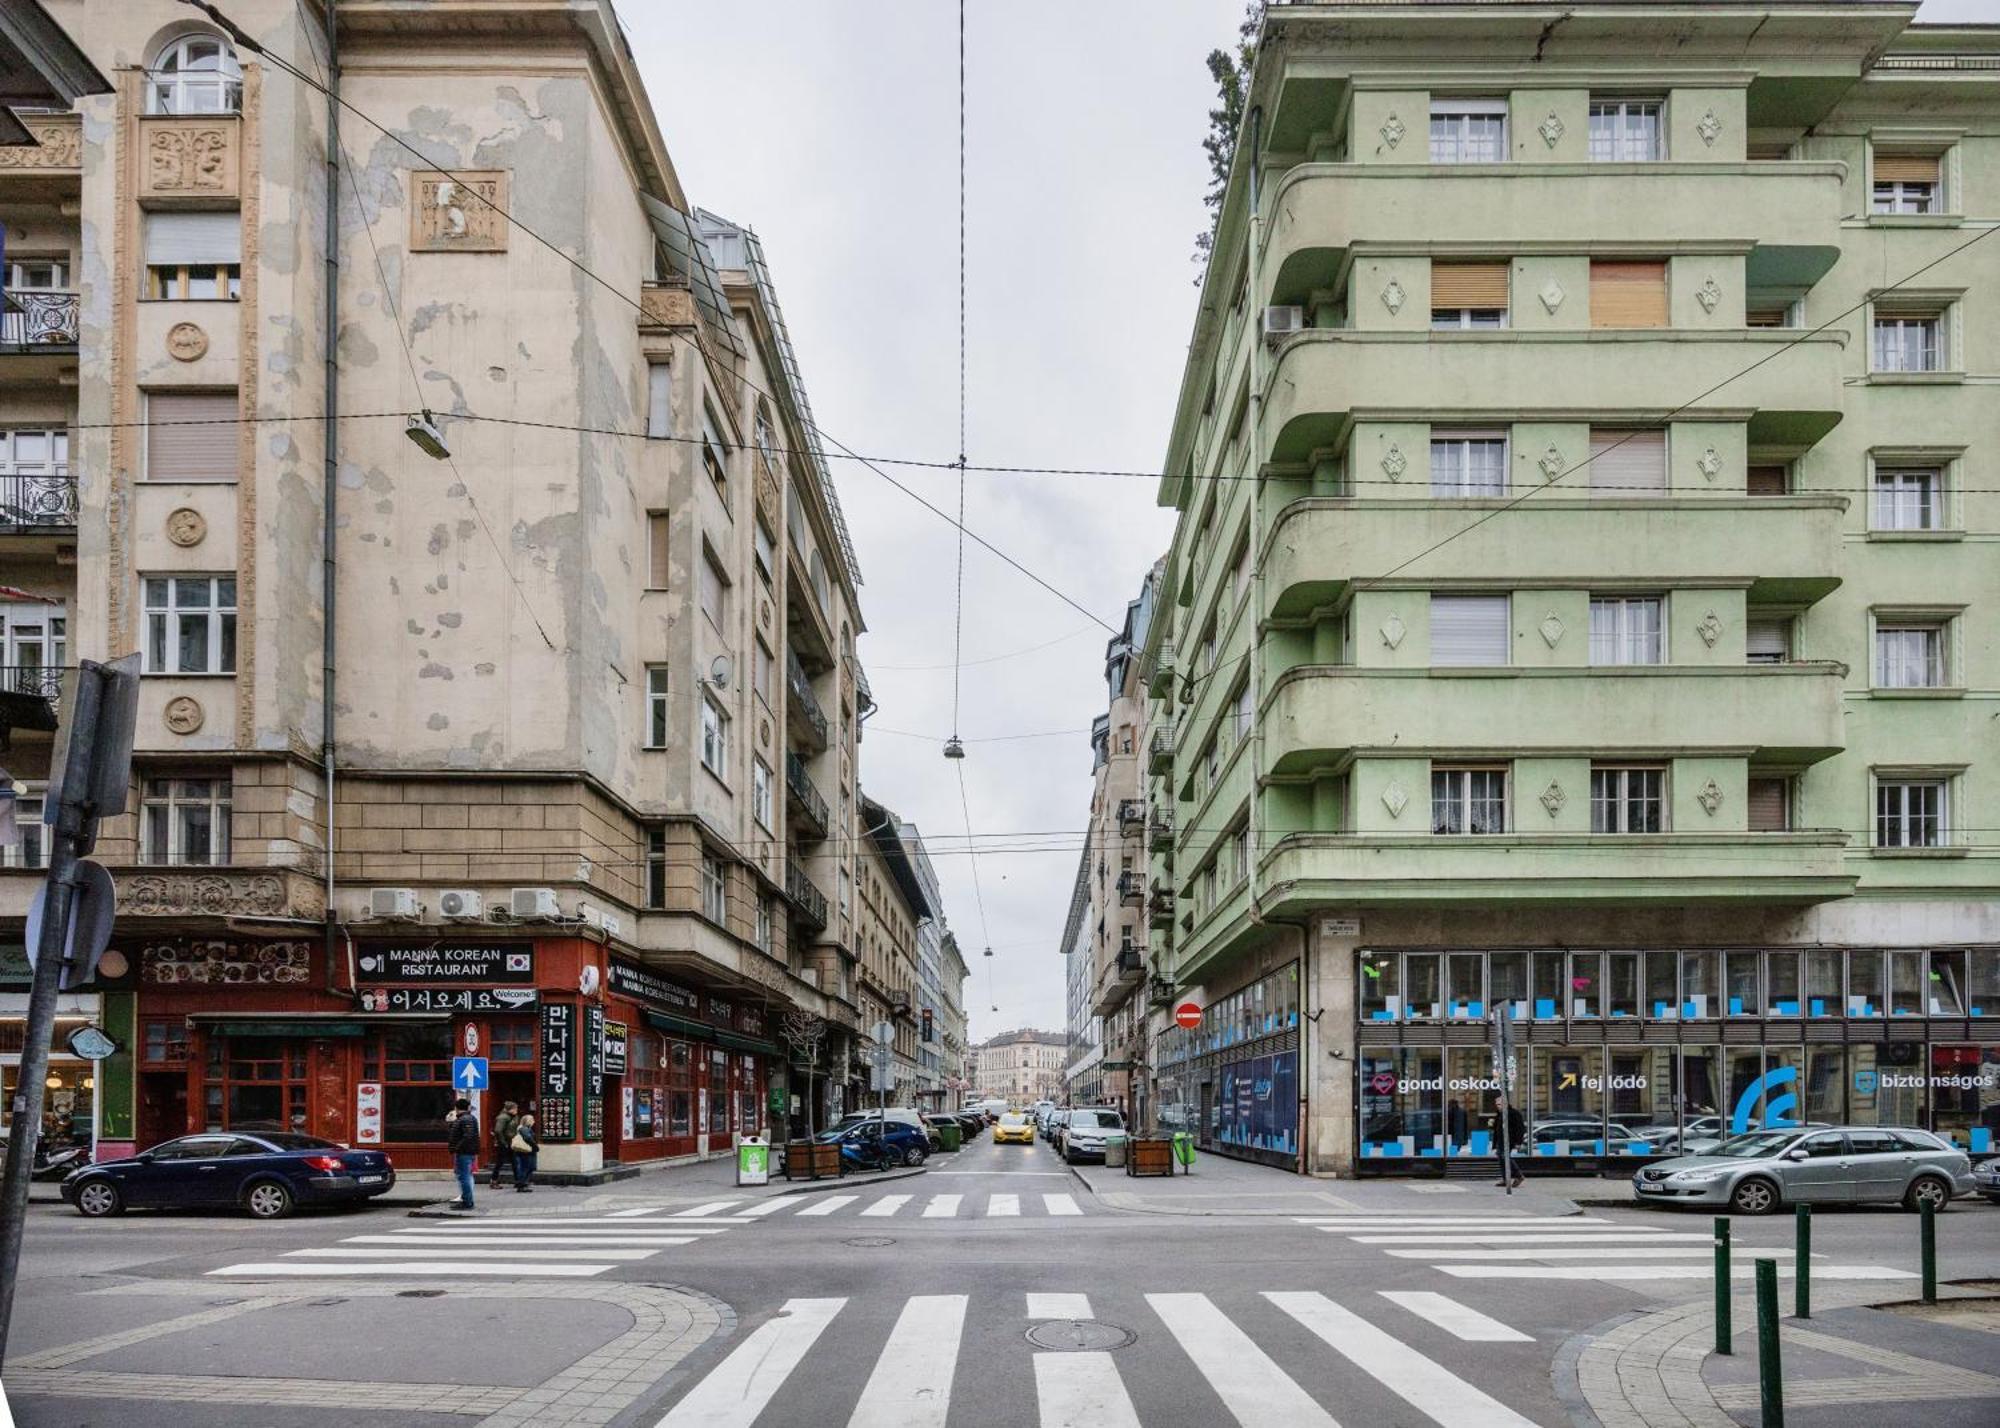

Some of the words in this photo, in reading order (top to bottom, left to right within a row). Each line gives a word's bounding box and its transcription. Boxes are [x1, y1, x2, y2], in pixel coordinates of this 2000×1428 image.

[390, 950, 440, 962] MANNA
[444, 950, 500, 961] KOREAN
[402, 964, 488, 976] RESTAURANT
[549, 1005, 569, 1094] 만나식당
